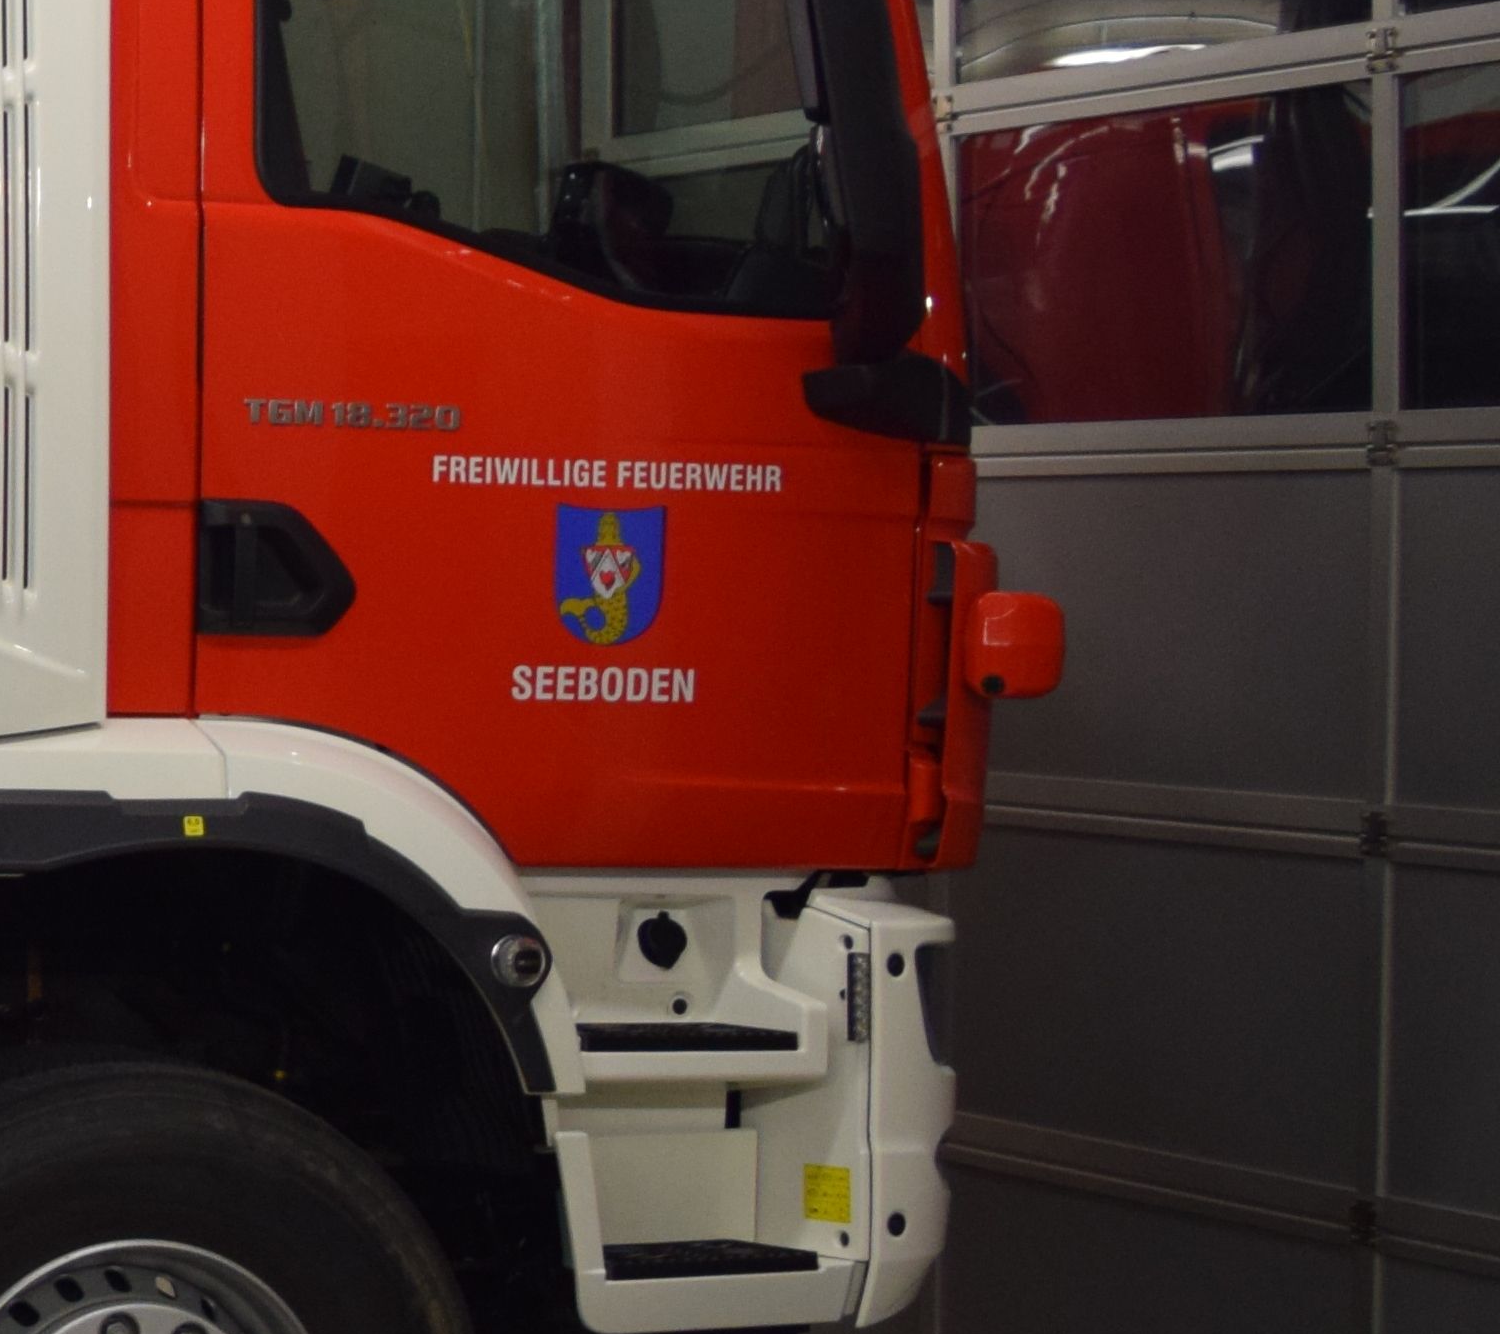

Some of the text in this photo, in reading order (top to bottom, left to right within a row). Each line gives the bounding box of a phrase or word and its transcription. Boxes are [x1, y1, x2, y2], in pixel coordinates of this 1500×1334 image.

[243, 397, 462, 431] TGM 18.320
[431, 453, 783, 493] FREIWILLIGE FEUERWEHR
[511, 664, 696, 704] SEEBODEN
